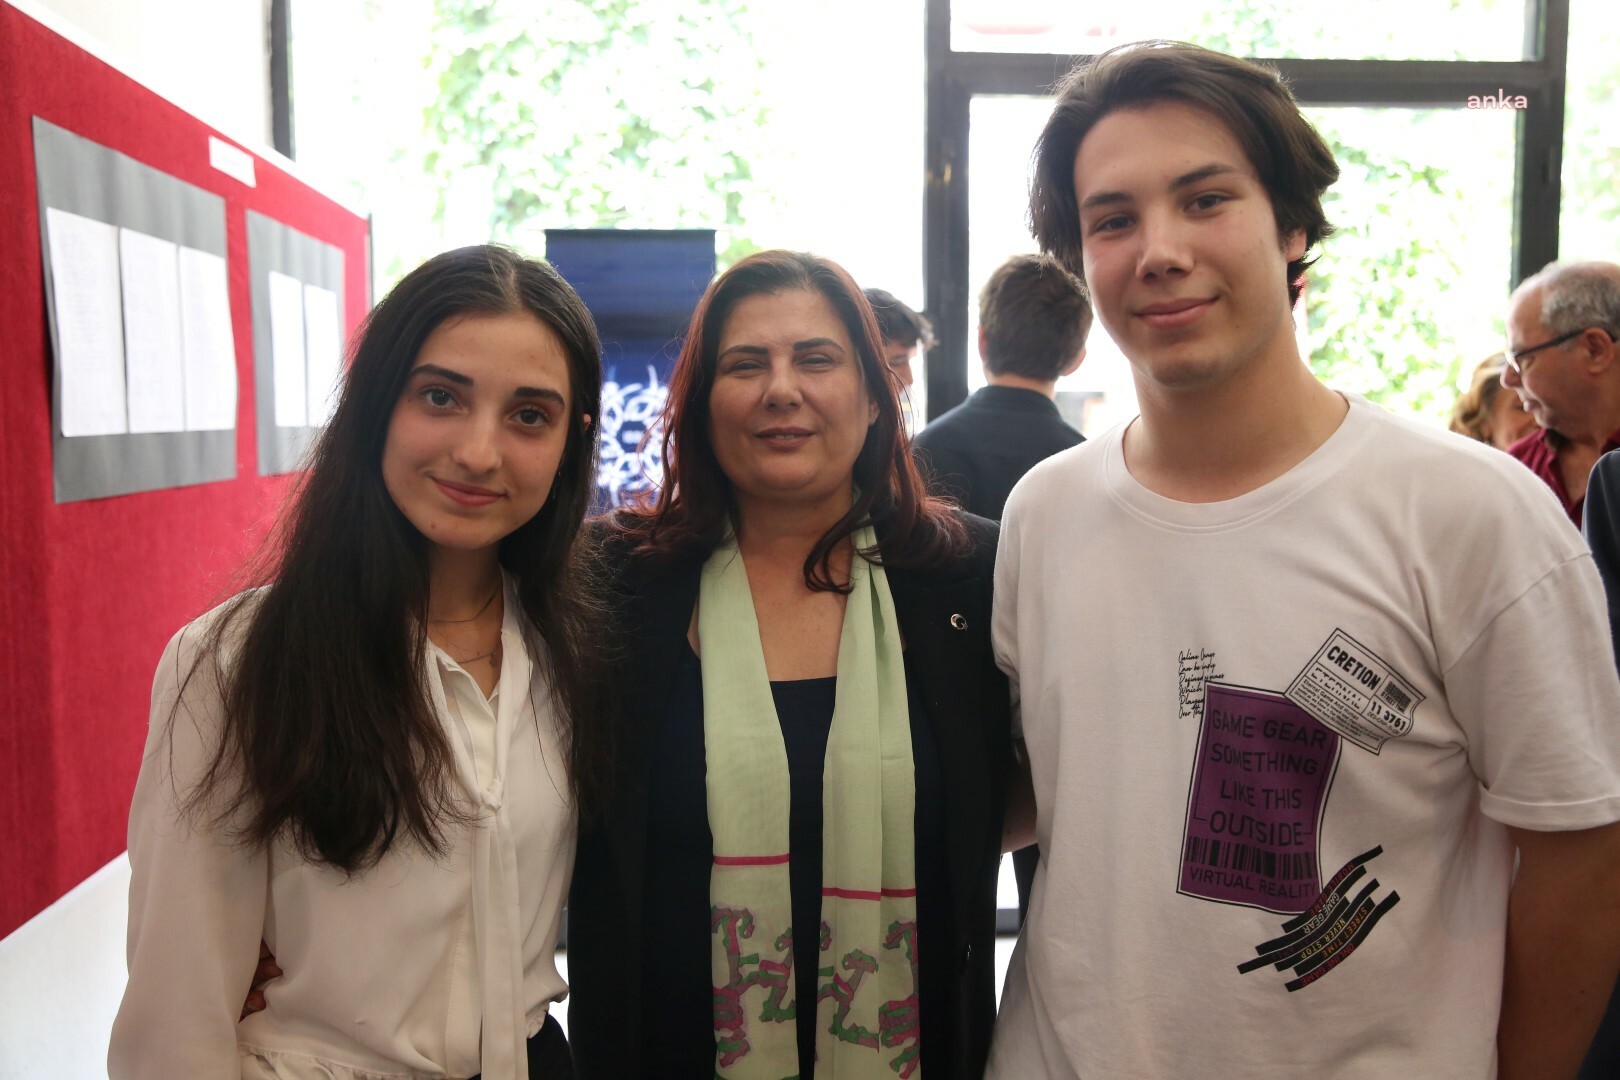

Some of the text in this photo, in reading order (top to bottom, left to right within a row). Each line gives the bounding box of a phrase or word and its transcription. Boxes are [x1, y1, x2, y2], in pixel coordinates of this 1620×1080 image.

[1327, 646, 1381, 690] CRETION
[1304, 679, 1320, 695] Eternal
[1320, 691, 1334, 703] Game
[1335, 700, 1344, 711] And
[1381, 692, 1395, 706] STREET
[1212, 710, 1256, 738] GAME
[1263, 720, 1327, 749] GEAR
[1371, 701, 1381, 715] 11
[1384, 710, 1406, 730] 3761
[1210, 743, 1318, 775] SOMETHING
[1220, 779, 1302, 810] LIKE THIS
[1210, 811, 1303, 846] OUTSIDE
[1190, 866, 1316, 898] VIRTUAL REALITY
[1308, 862, 1355, 916] MOBILE GAME
[1302, 892, 1339, 934] GAME GEAR
[1323, 917, 1345, 941] NEVER
[1321, 906, 1367, 958] STREET TIME
[1301, 941, 1321, 959] STOP
[1326, 941, 1354, 968] ONLINE
[1300, 966, 1326, 986] GAME
